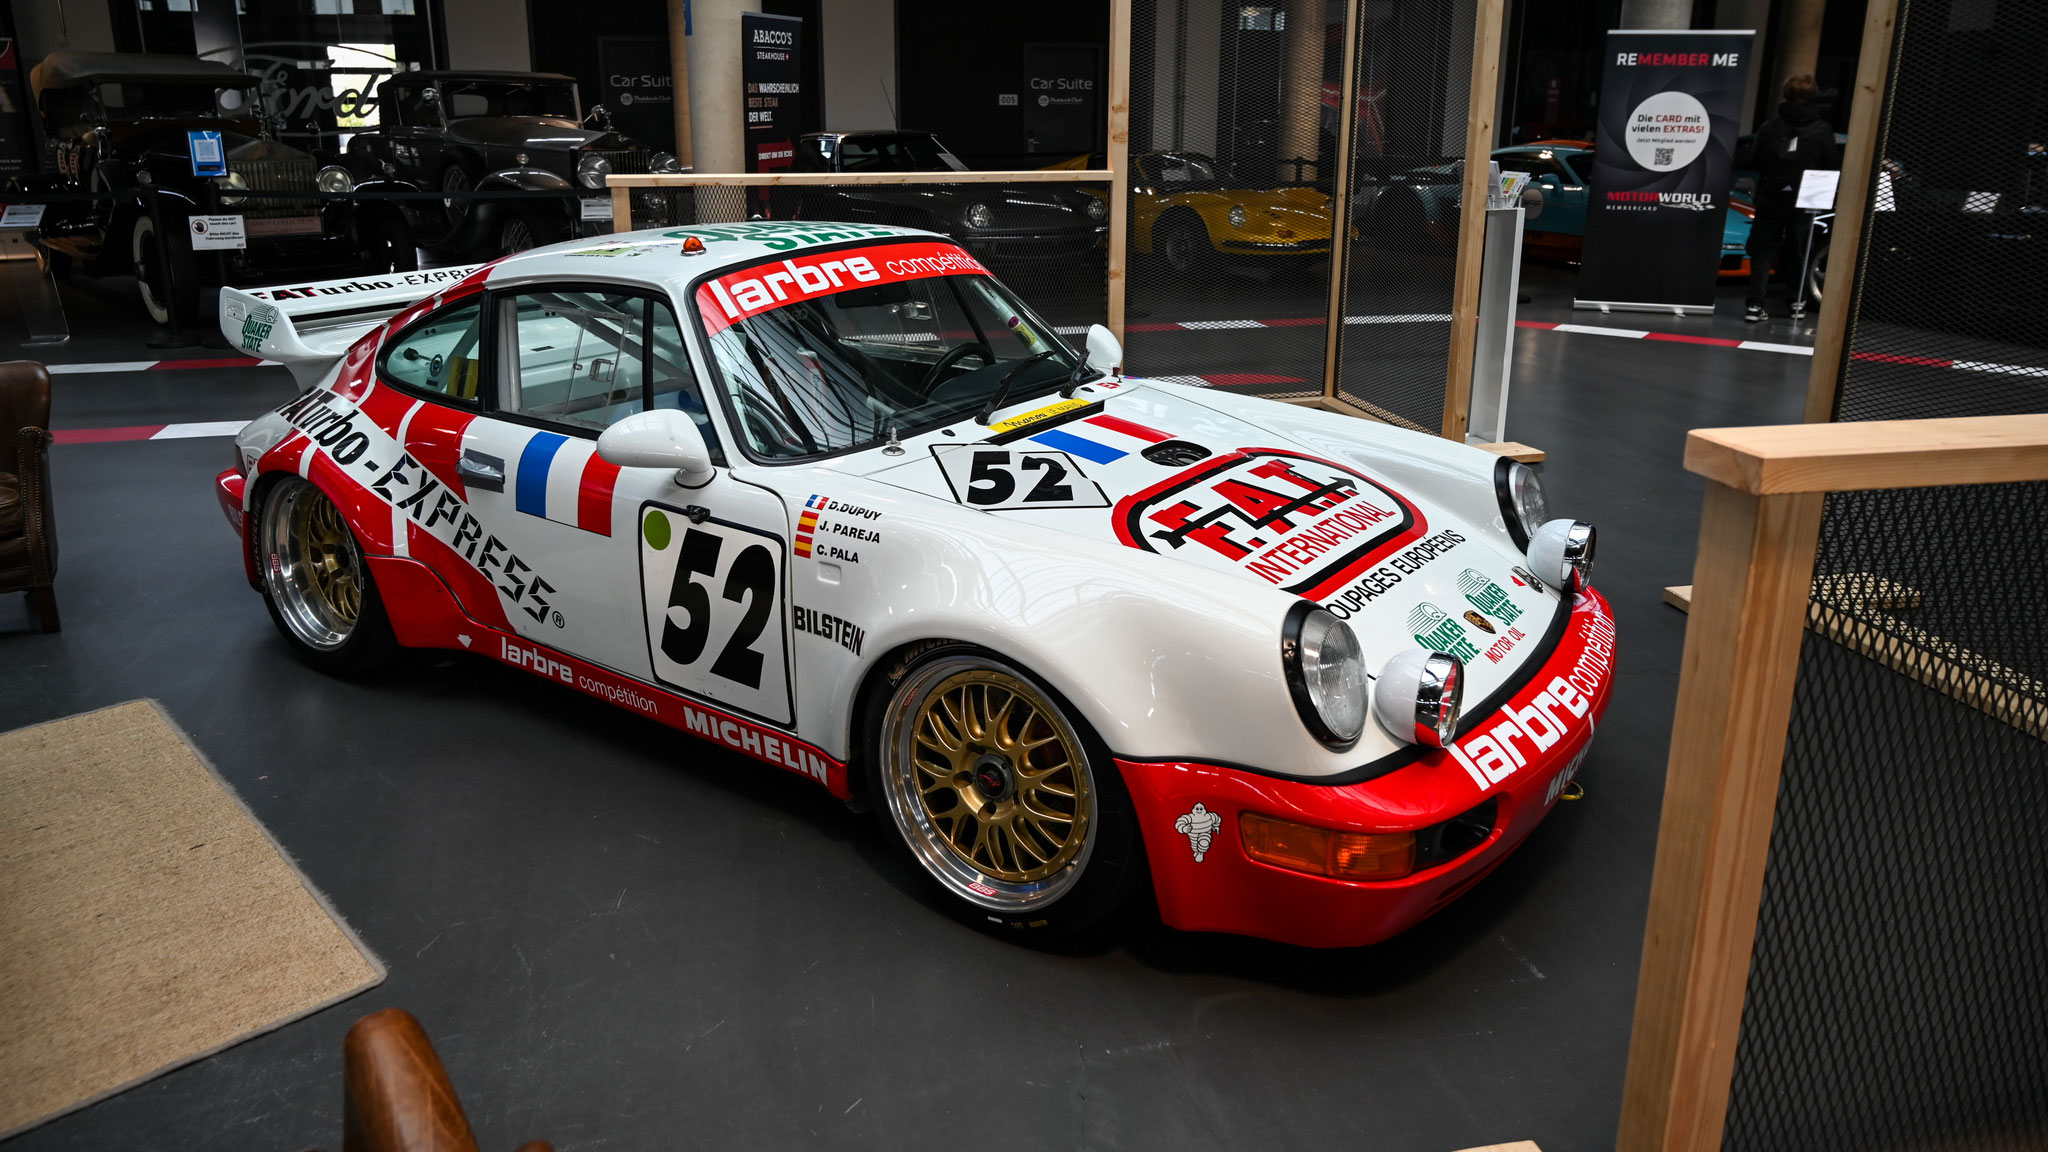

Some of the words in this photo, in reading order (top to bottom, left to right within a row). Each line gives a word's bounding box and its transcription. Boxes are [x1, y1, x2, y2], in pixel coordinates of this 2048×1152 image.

[753, 29, 792, 45] ABACCO'S
[756, 51, 785, 61] STEAKHOUSE
[1616, 53, 1710, 67] REMEMBER
[1712, 53, 1739, 67] ME
[610, 74, 638, 88] Car
[641, 74, 673, 88] Suit
[748, 83, 759, 94] DAS
[759, 83, 800, 94] WAHRSCHEINLICH
[1030, 77, 1055, 90] Car
[1057, 77, 1093, 90] Suite
[748, 97, 763, 108] BESTE
[764, 97, 779, 108] STEAK
[748, 112, 759, 123] DER
[1637, 114, 1654, 123] Die
[1655, 114, 1683, 123] CARD
[1684, 114, 1702, 123] mit
[1632, 125, 1661, 133] vielen
[1663, 125, 1705, 134] EXTRAS!
[1607, 191, 1712, 204] MOTORWORLD
[708, 255, 882, 318] larbre
[886, 251, 982, 275] compétitio
[242, 314, 273, 340] QUAKER
[242, 335, 262, 353] STATE
[966, 450, 1075, 506] 52
[819, 521, 830, 533] J.
[830, 523, 881, 544] PAREJA
[1244, 500, 1397, 585] INTERNATIONAL
[816, 544, 828, 557] C.
[830, 547, 860, 564] PALA
[1326, 568, 1402, 620] OUPAGES
[1390, 529, 1467, 576] EUROPÉENS
[660, 527, 776, 691] 52
[1465, 583, 1509, 616] QUAKER
[1492, 599, 1523, 626] STATE
[793, 605, 866, 657] BILSTEIN
[1447, 636, 1481, 666] TATE
[1484, 636, 1516, 665] MOTOR
[1508, 626, 1526, 642] OIL
[501, 636, 574, 685] larbre
[578, 674, 659, 715] compétition
[1445, 675, 1591, 792] larbre
[1567, 610, 1616, 697] compétition
[683, 706, 829, 787] MICHELIN
[968, 882, 997, 896] BBS
